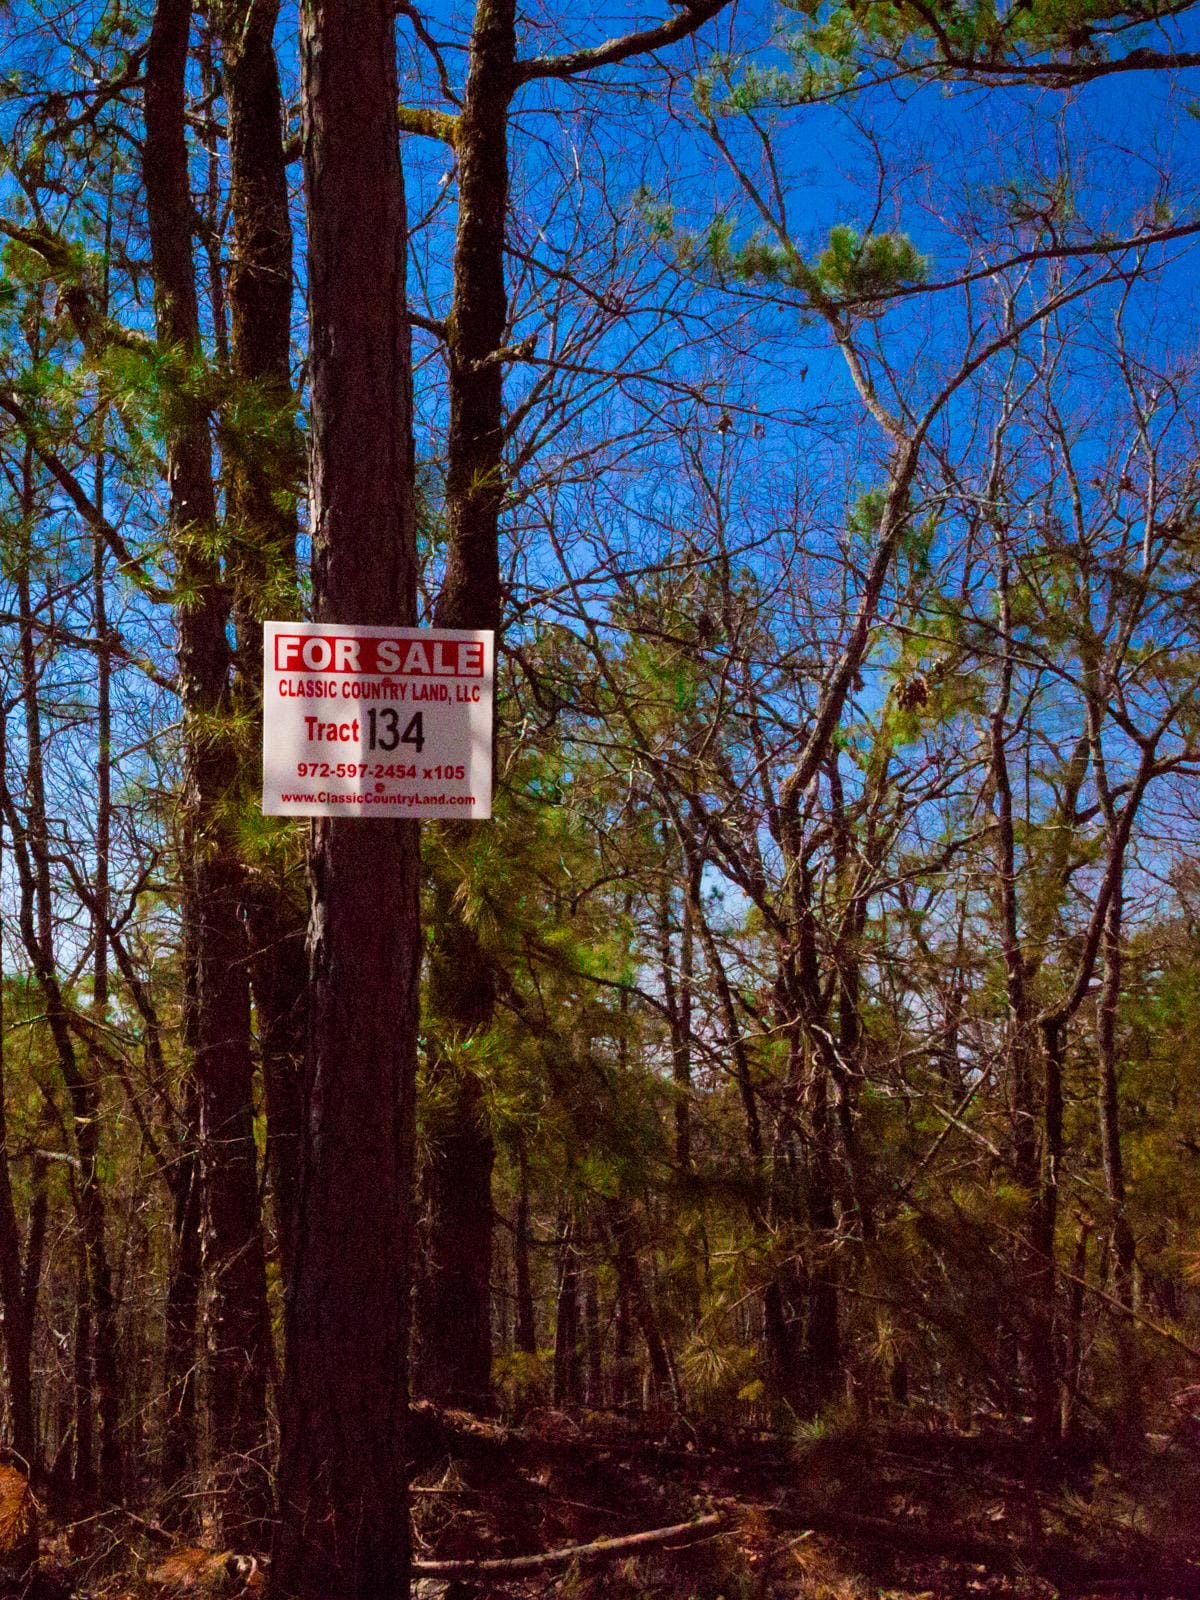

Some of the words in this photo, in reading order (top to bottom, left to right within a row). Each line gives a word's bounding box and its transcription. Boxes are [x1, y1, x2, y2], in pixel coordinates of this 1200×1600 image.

[277, 636, 362, 672] FOR
[375, 640, 481, 675] SALE
[279, 679, 337, 698] CLASSIC
[342, 681, 408, 701] COUNTRY
[412, 684, 452, 705] LAND,
[456, 685, 480, 702] LLC
[304, 716, 359, 742] Tract
[367, 708, 425, 753] 134
[297, 763, 417, 780] 972-597-2454
[422, 766, 465, 780] x105
[281, 791, 476, 807] www.ClassicCountryLand.com
